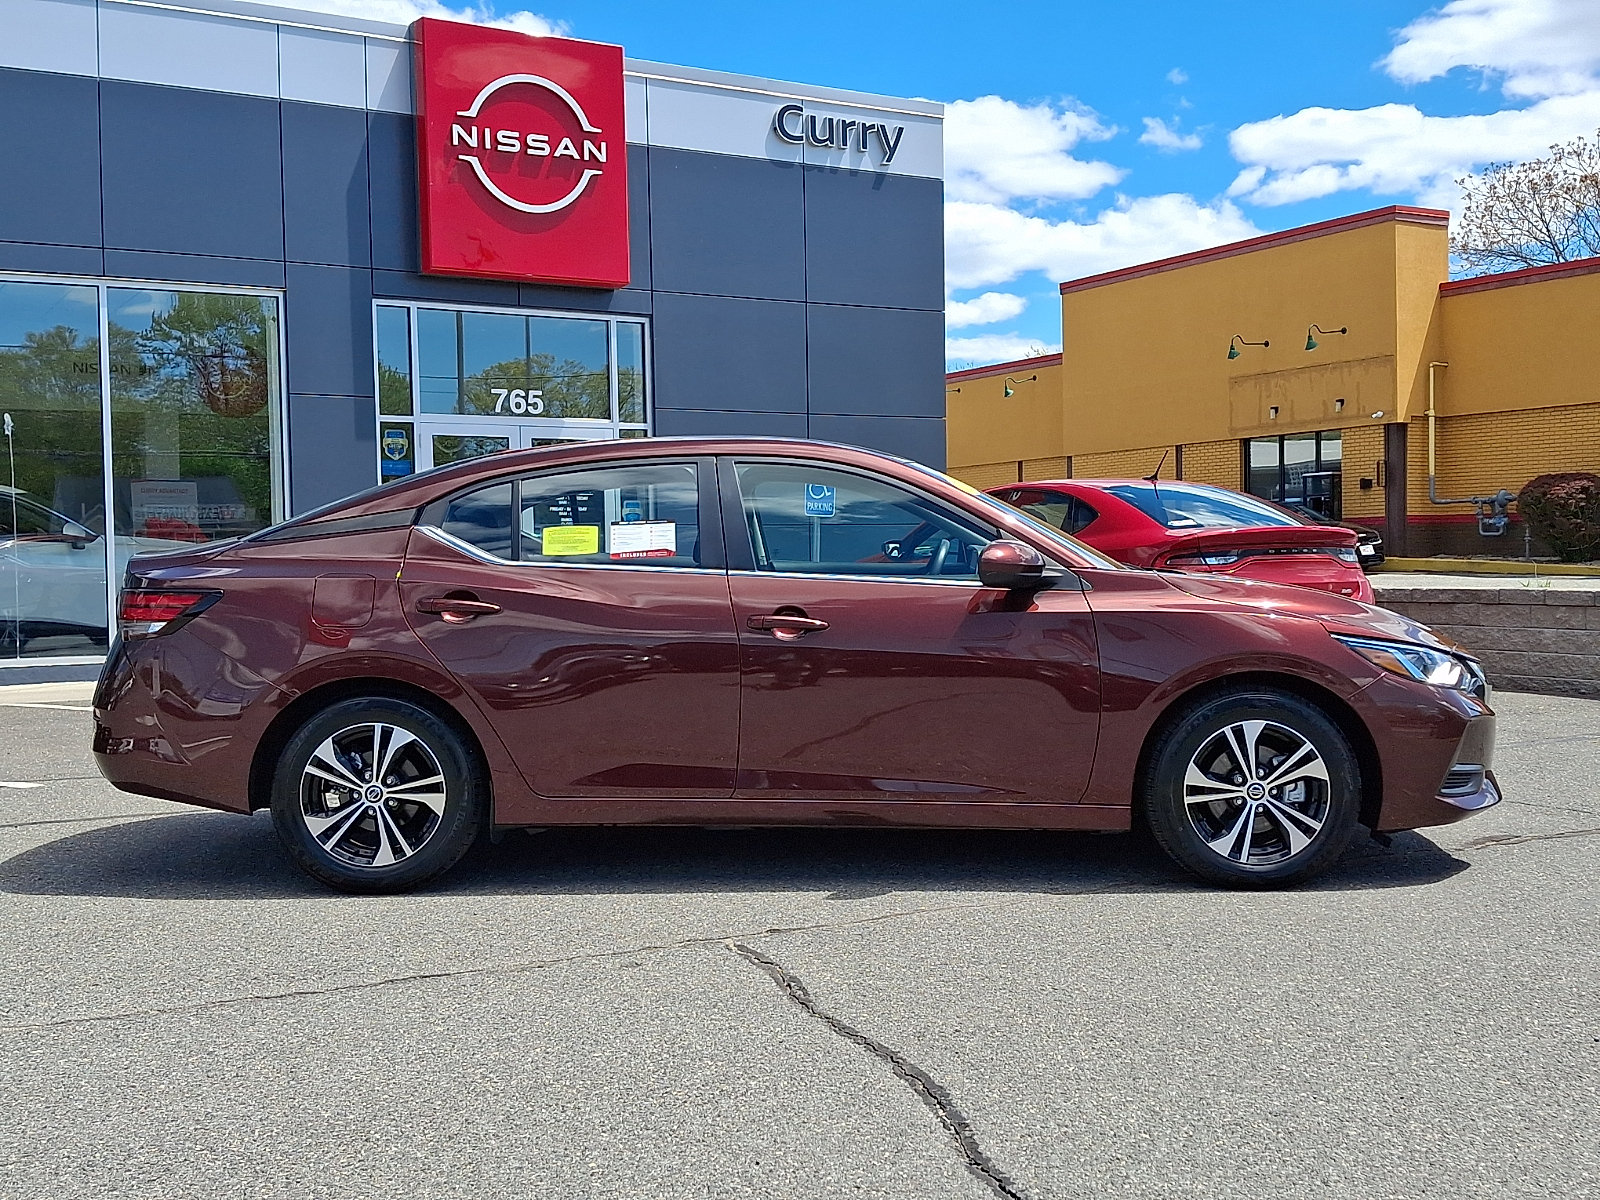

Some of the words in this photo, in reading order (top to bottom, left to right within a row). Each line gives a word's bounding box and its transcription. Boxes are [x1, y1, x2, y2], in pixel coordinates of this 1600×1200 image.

[452, 124, 607, 163] NISSAN
[775, 103, 904, 165] Curry
[491, 388, 544, 415] 765
[807, 501, 833, 512] PARKING
